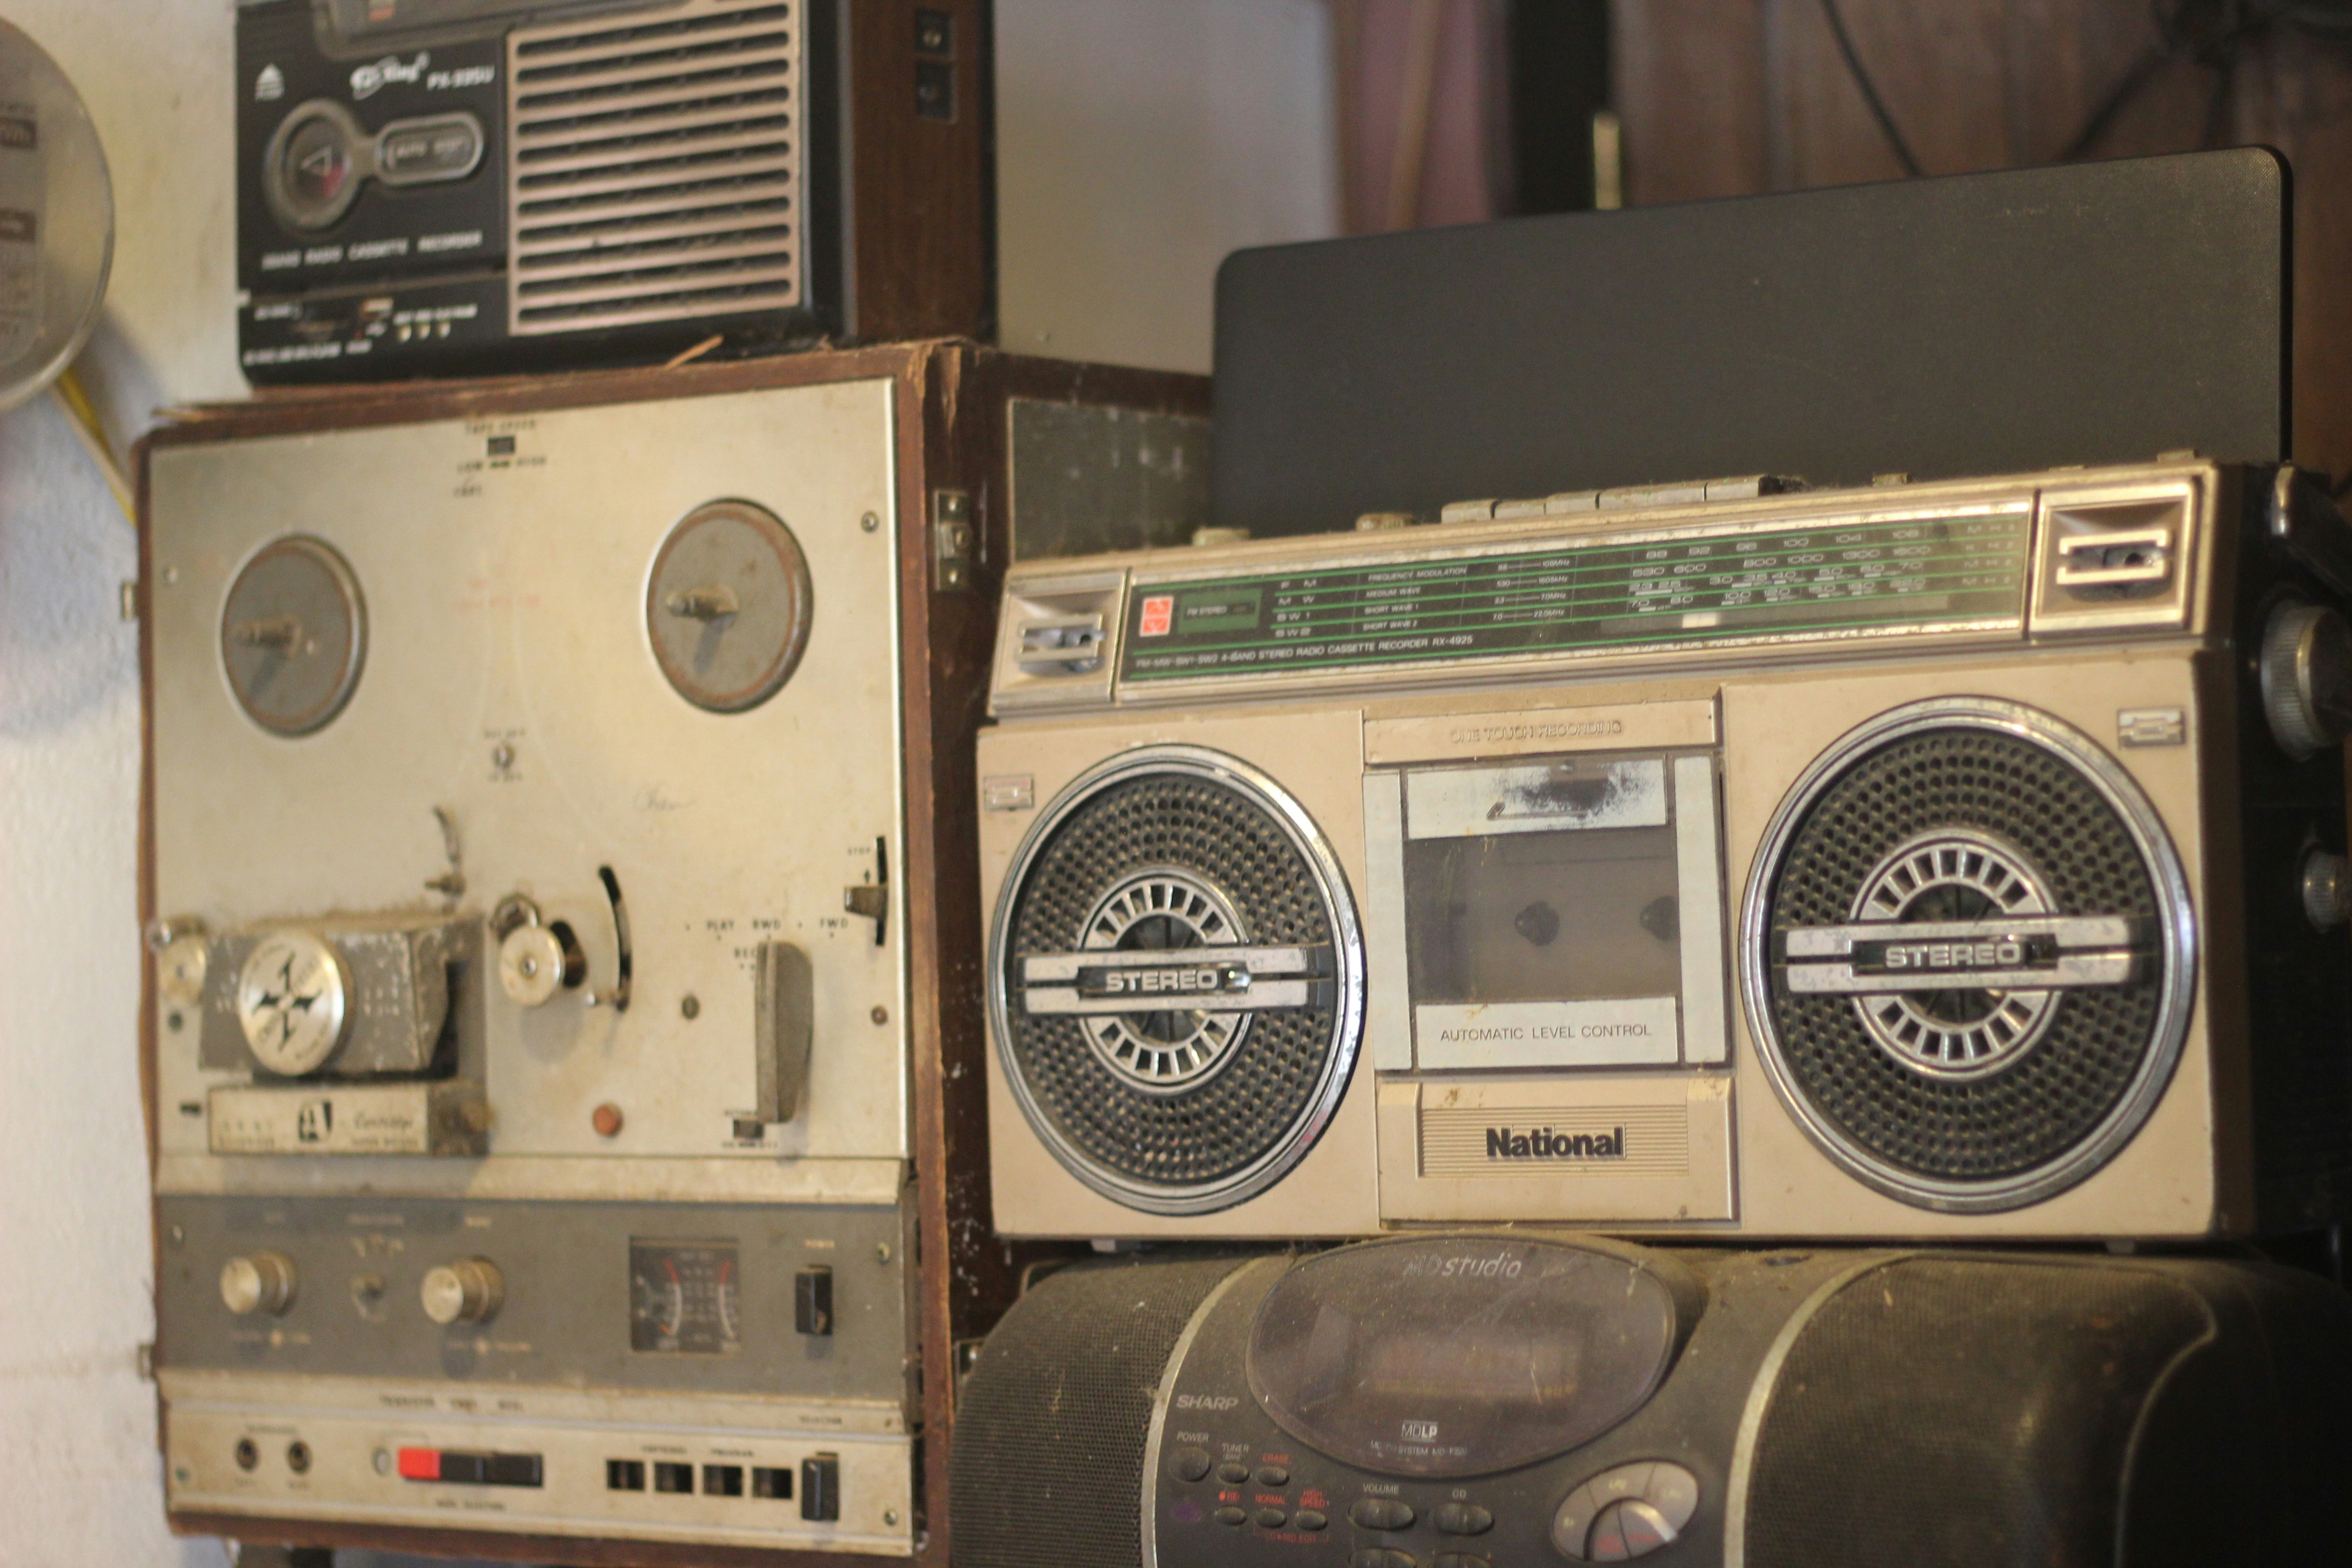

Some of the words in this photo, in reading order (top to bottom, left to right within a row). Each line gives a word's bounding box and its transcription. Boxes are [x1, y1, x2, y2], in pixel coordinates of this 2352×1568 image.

[1784, 537, 1809, 548] 100
[1788, 553, 1823, 564] 1000
[1368, 571, 1413, 582] FREQUENCY
[1416, 567, 1468, 578] MODULATION
[1366, 588, 1398, 598] MEDIUM
[1400, 586, 1421, 596] WAVE
[1364, 605, 1388, 615] SHORT
[1391, 603, 1412, 613] WAVE
[1362, 622, 1387, 632] SHORT
[1389, 619, 1411, 630] WAVE
[1258, 648, 1294, 660] STEREO
[1296, 645, 1325, 657] RADIO
[1327, 642, 1375, 655] CASSETTE
[1378, 638, 1428, 651] RECORDER
[1538, 720, 1622, 739] RECORDING
[1885, 943, 2021, 969] STEREO
[1105, 968, 1218, 992] STEREO
[1440, 1026, 1524, 1043] AUTOMATIC
[1532, 1024, 1576, 1039] LEVEL
[1581, 1021, 1652, 1038] CONTROL
[1486, 1125, 1623, 1158] National
[1176, 1394, 1239, 1410] SHARP
[1176, 1431, 1209, 1442] POWER
[1363, 1483, 1399, 1495] VOLUME
